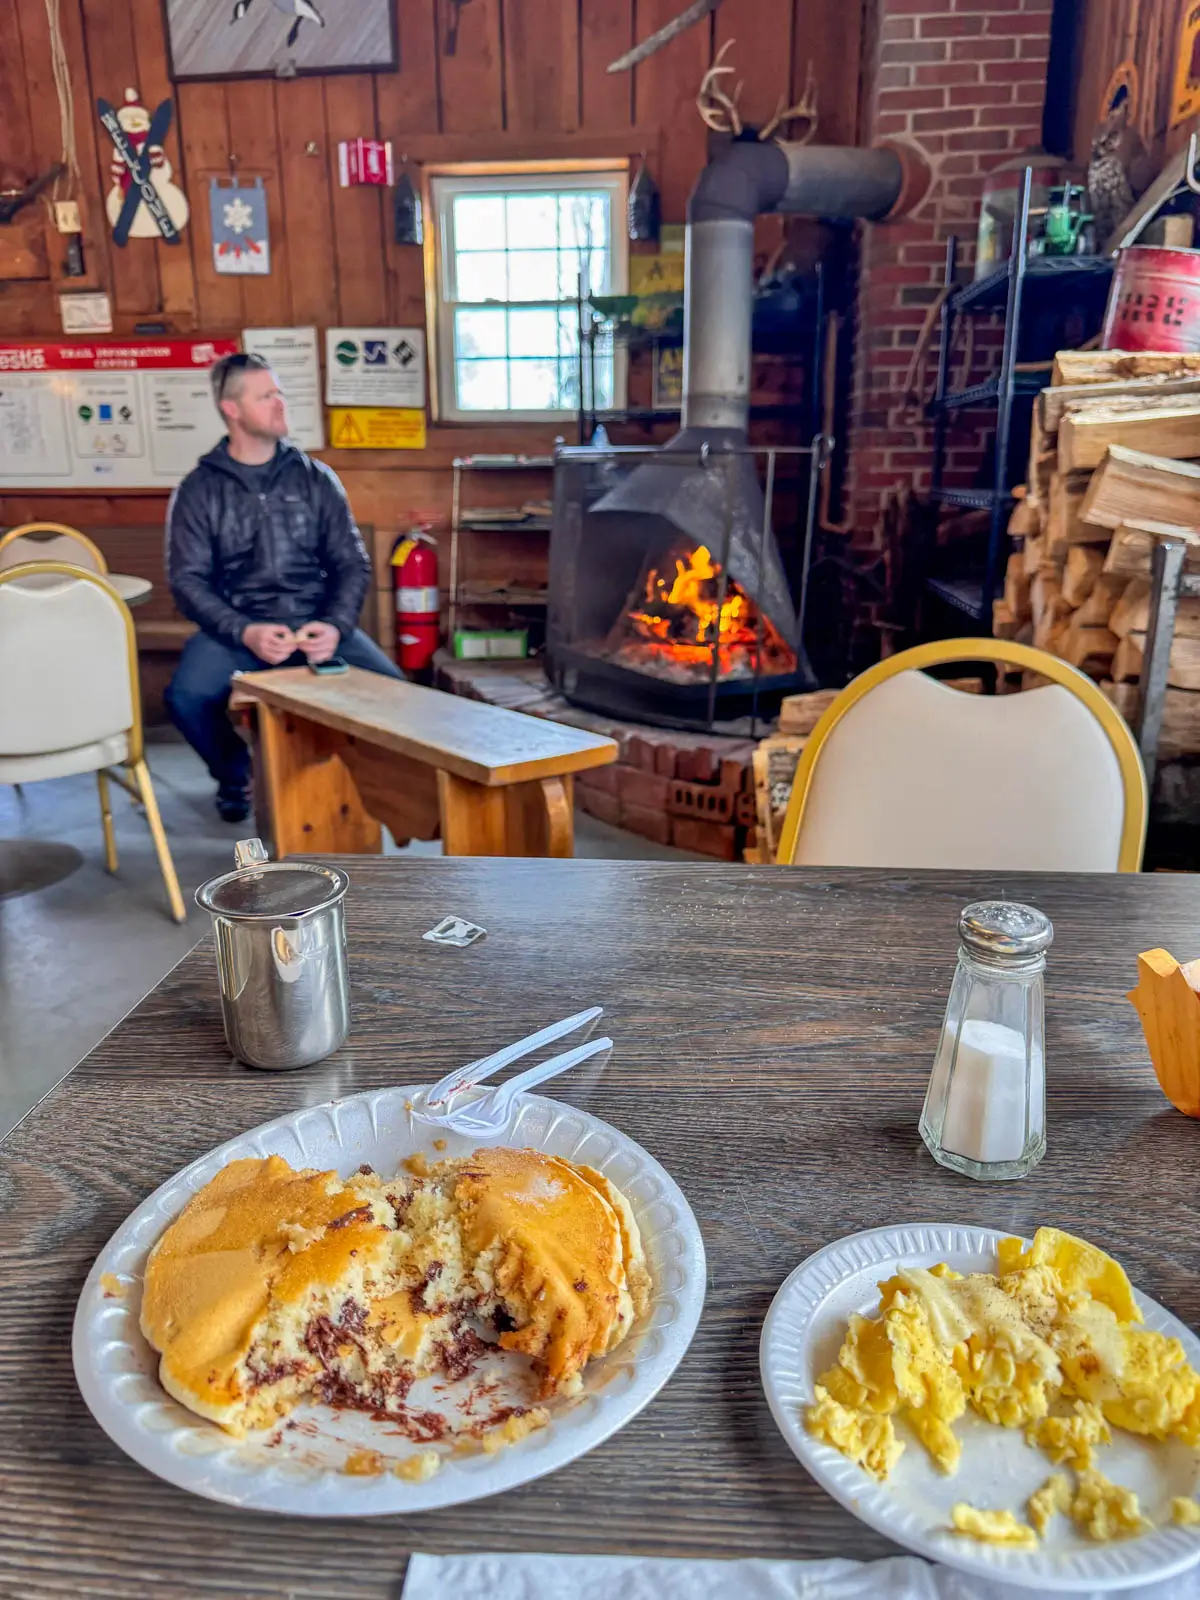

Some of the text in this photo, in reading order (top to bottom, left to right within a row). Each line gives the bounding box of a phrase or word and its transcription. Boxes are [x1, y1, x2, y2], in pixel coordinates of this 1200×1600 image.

[100, 111, 176, 239] WELCOME
[59, 346, 171, 359] TRAIL INFORMATION
